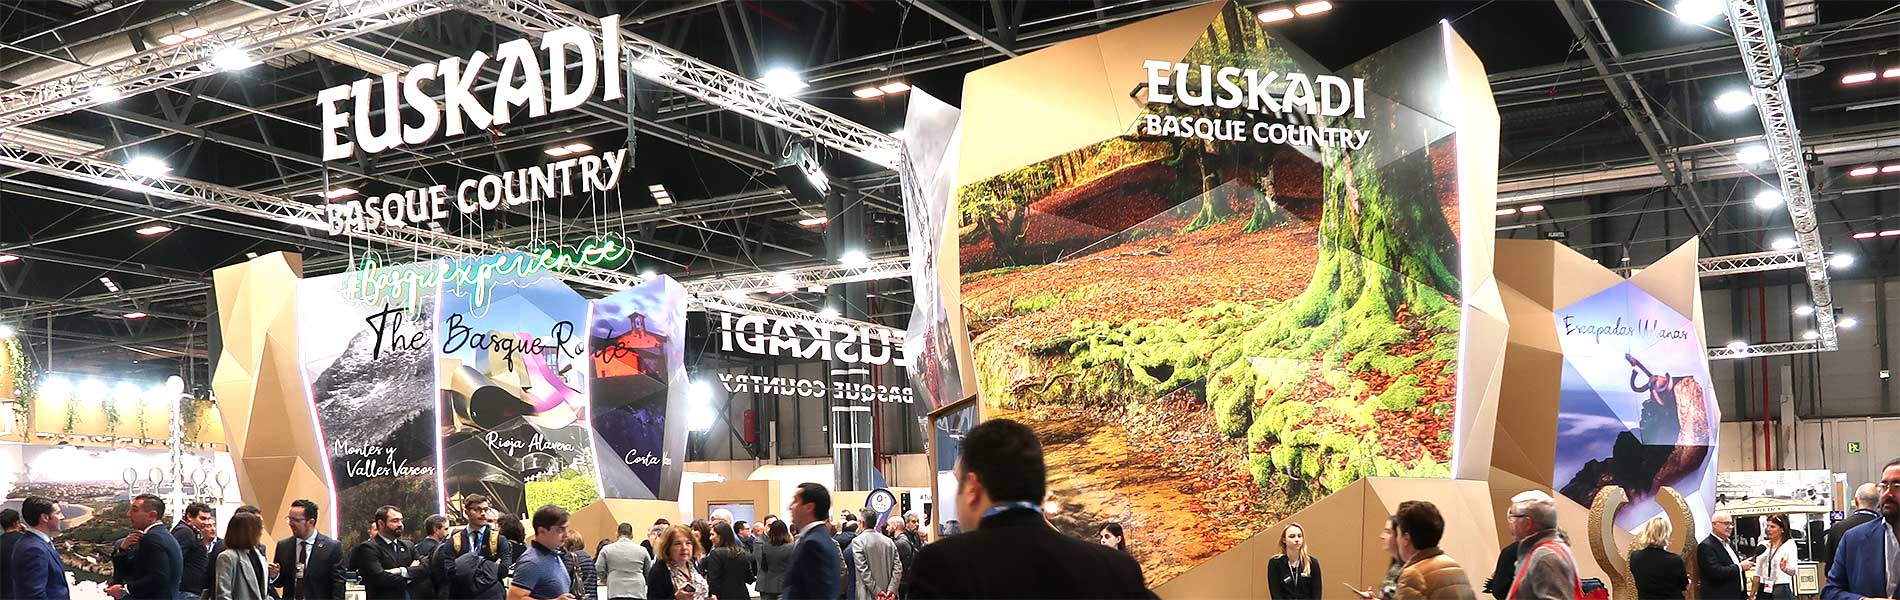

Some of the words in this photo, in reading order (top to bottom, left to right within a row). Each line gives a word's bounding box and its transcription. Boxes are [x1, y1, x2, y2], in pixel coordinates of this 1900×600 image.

[316, 14, 624, 161] EUSKADI
[1143, 59, 1366, 118] EUSKADI
[1144, 114, 1247, 142] BASQUE
[1252, 121, 1370, 150] COUNTRY
[326, 184, 449, 235] BASQUE
[457, 148, 628, 214] COUNTRY
[366, 302, 428, 360] The
[443, 313, 546, 371] Basque
[1563, 315, 1634, 344] Escapadas
[1638, 319, 1689, 340] Uanas
[334, 438, 383, 457] Montes
[385, 446, 397, 464] y
[485, 430, 525, 456] Rioja
[624, 448, 660, 467] Costa
[346, 459, 392, 477] Valles
[392, 460, 436, 477] Vascos
